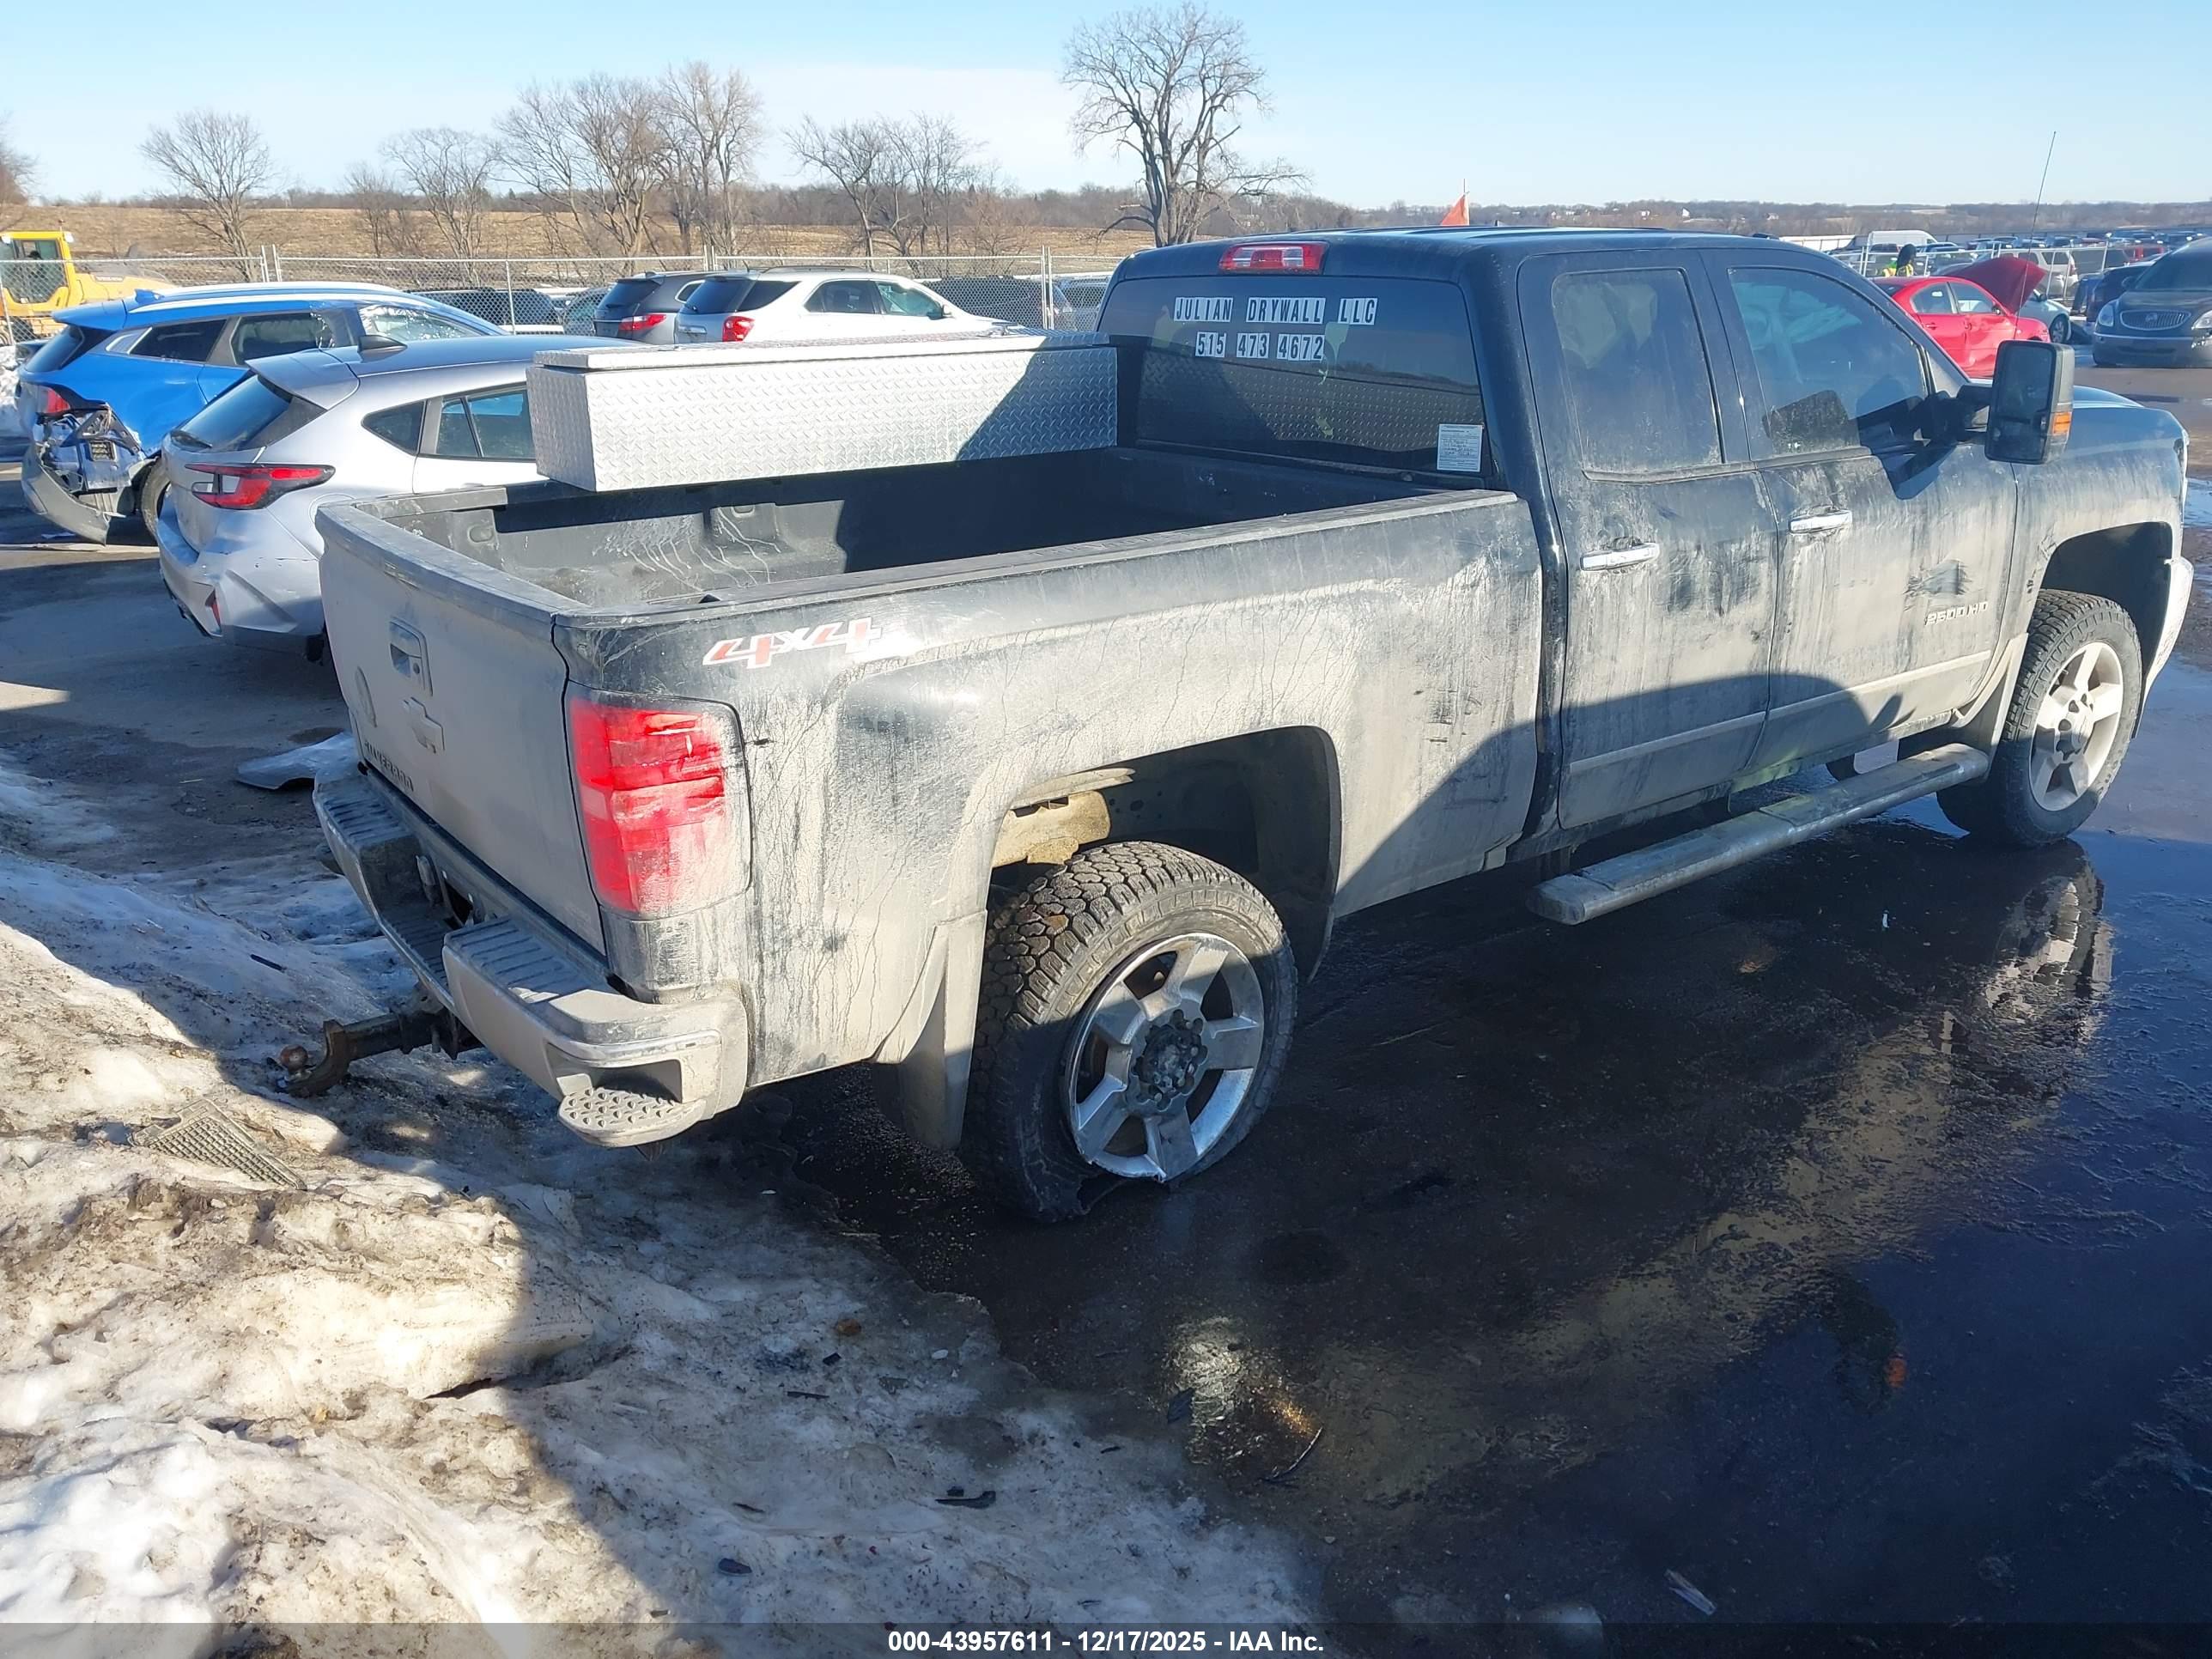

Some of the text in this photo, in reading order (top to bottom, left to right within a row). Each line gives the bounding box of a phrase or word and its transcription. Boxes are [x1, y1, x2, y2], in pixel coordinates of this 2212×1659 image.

[1175, 297, 1376, 324] JULIAN DRYWALL LLC
[1197, 332, 1323, 360] 515 473 4672
